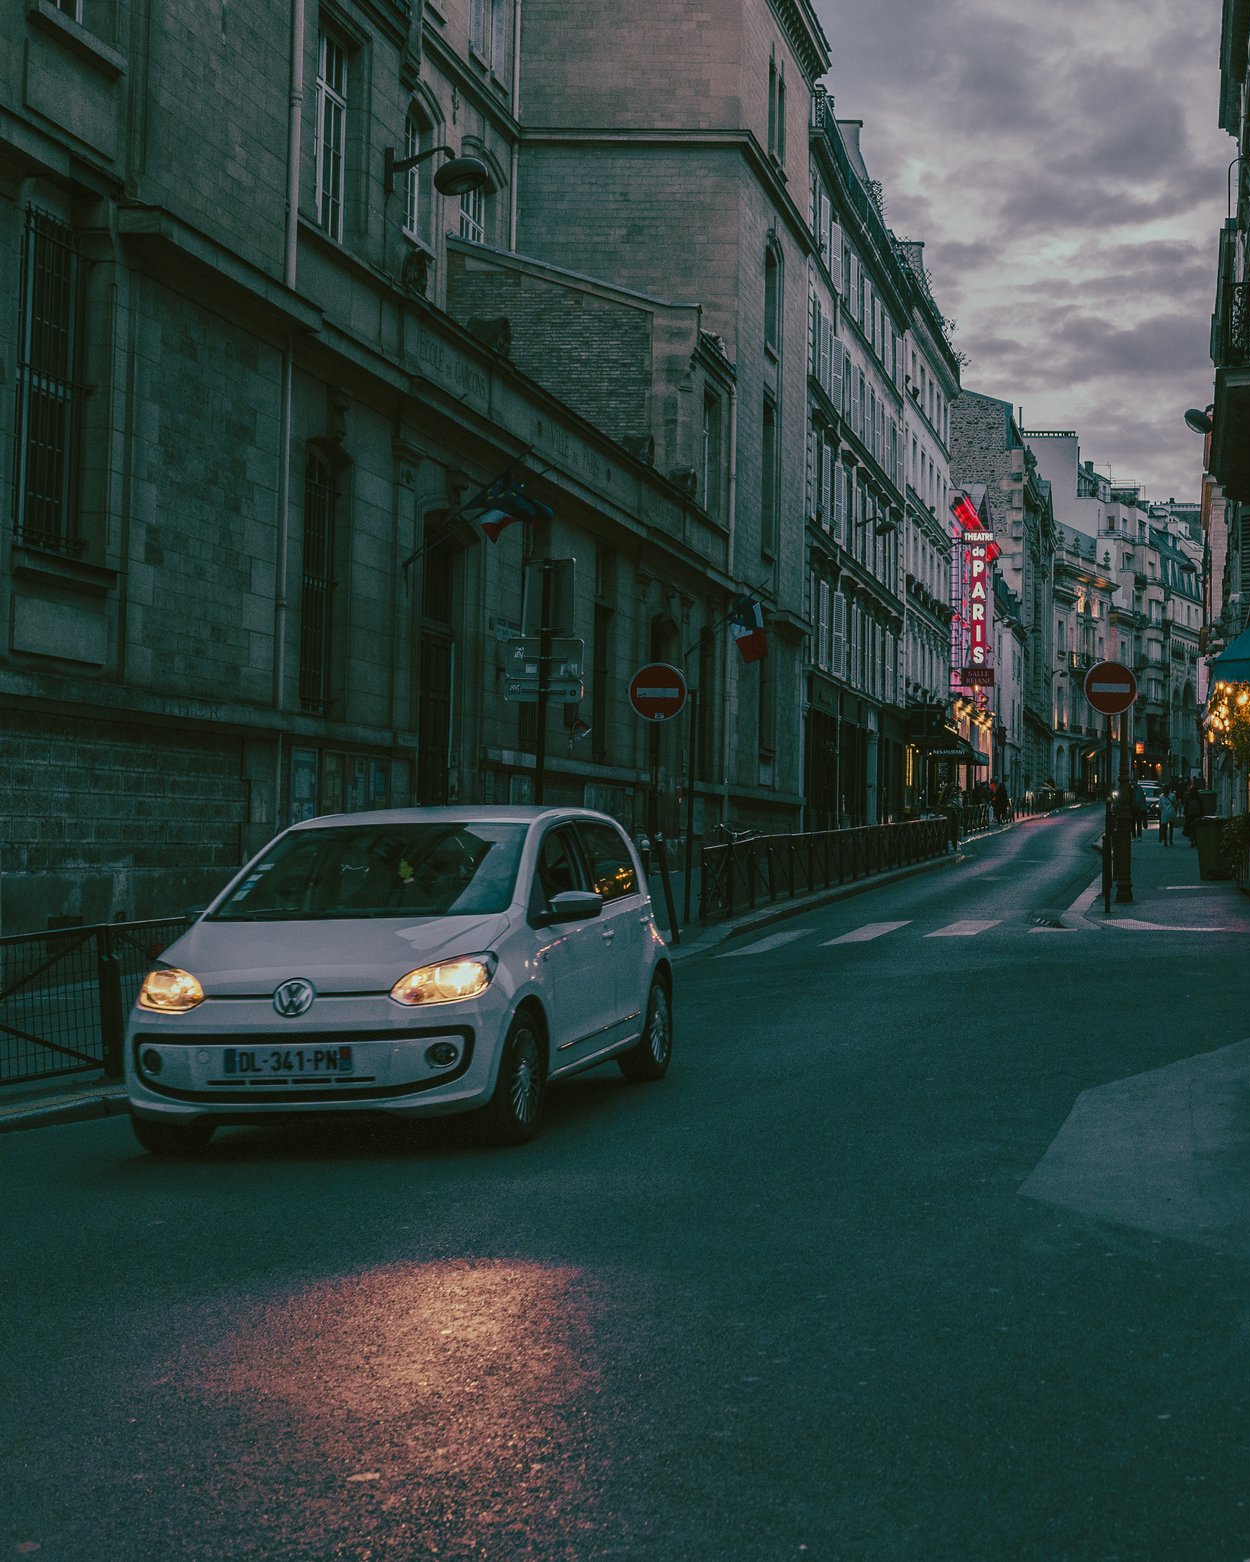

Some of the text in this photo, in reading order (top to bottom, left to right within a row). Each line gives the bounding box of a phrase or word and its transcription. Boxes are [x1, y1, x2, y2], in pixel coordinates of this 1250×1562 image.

[963, 532, 994, 542] THEATRE
[971, 546, 985, 558] de
[971, 559, 986, 665] PARIS
[238, 1050, 338, 1073] DL-341-PN
